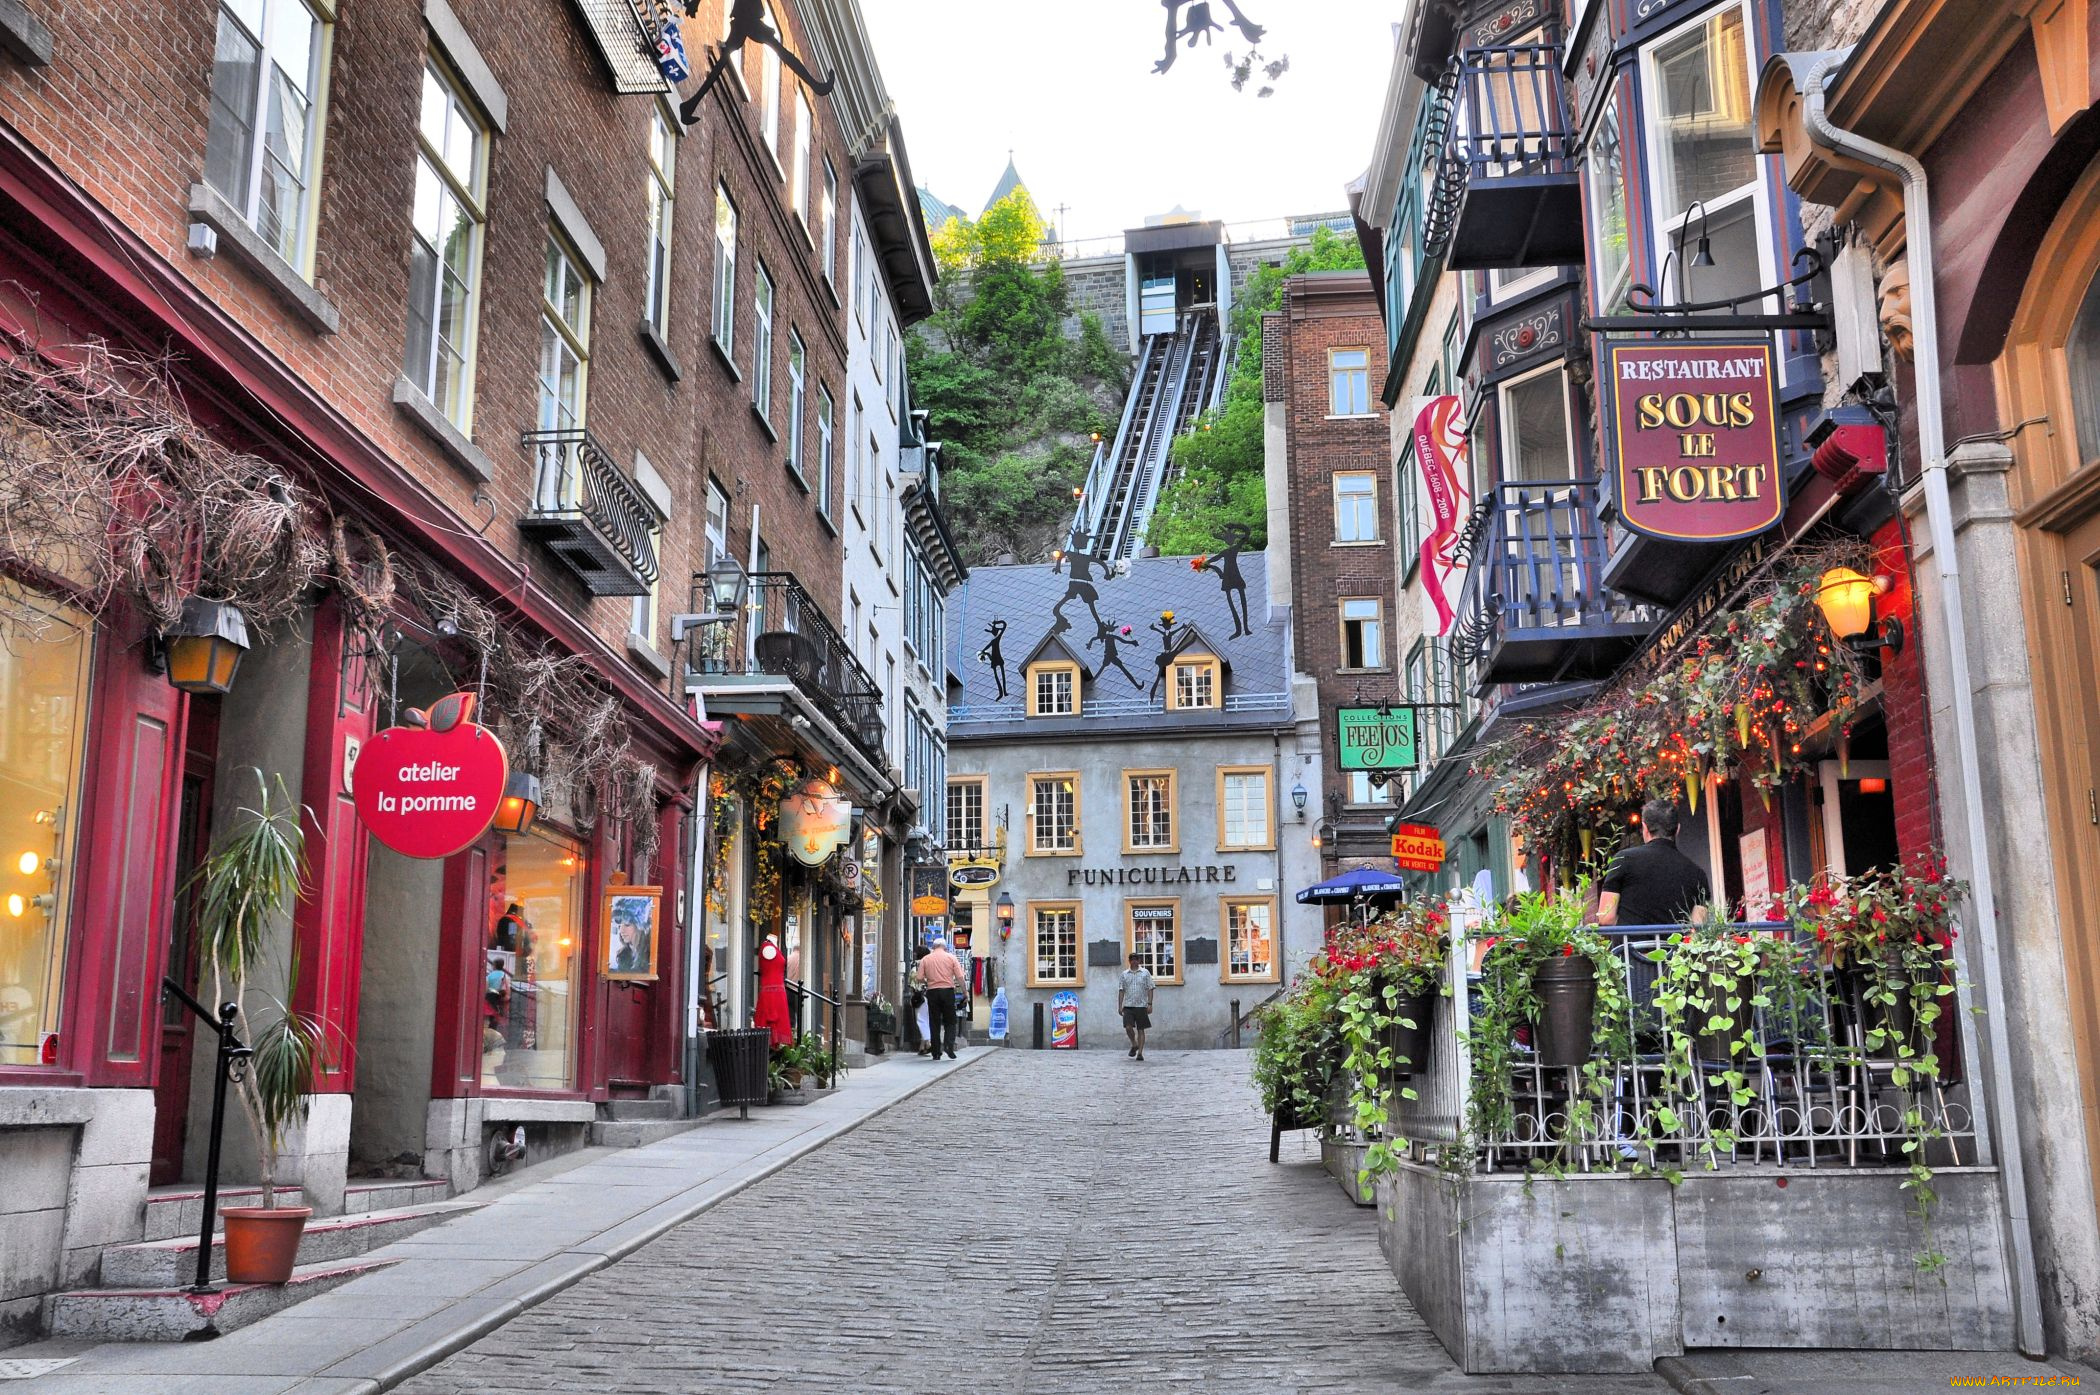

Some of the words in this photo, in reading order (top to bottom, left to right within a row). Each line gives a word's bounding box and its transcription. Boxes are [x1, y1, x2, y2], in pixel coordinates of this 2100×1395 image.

[1619, 357, 1764, 381] RESTAURANT
[1635, 391, 1755, 430] SOUS
[1418, 435, 1435, 470] QUÉBEC
[1680, 432, 1716, 458] LE
[1634, 463, 1766, 503] FORT
[398, 761, 460, 782] atelier
[1374, 774, 1383, 785] 52
[377, 791, 396, 812] la
[400, 795, 476, 816] pomme
[1394, 838, 1443, 858] Kodak
[1067, 865, 1236, 886] FUNICULAIRE
[1411, 861, 1427, 869] VENTE
[1134, 909, 1172, 918] SOUVENIRS
